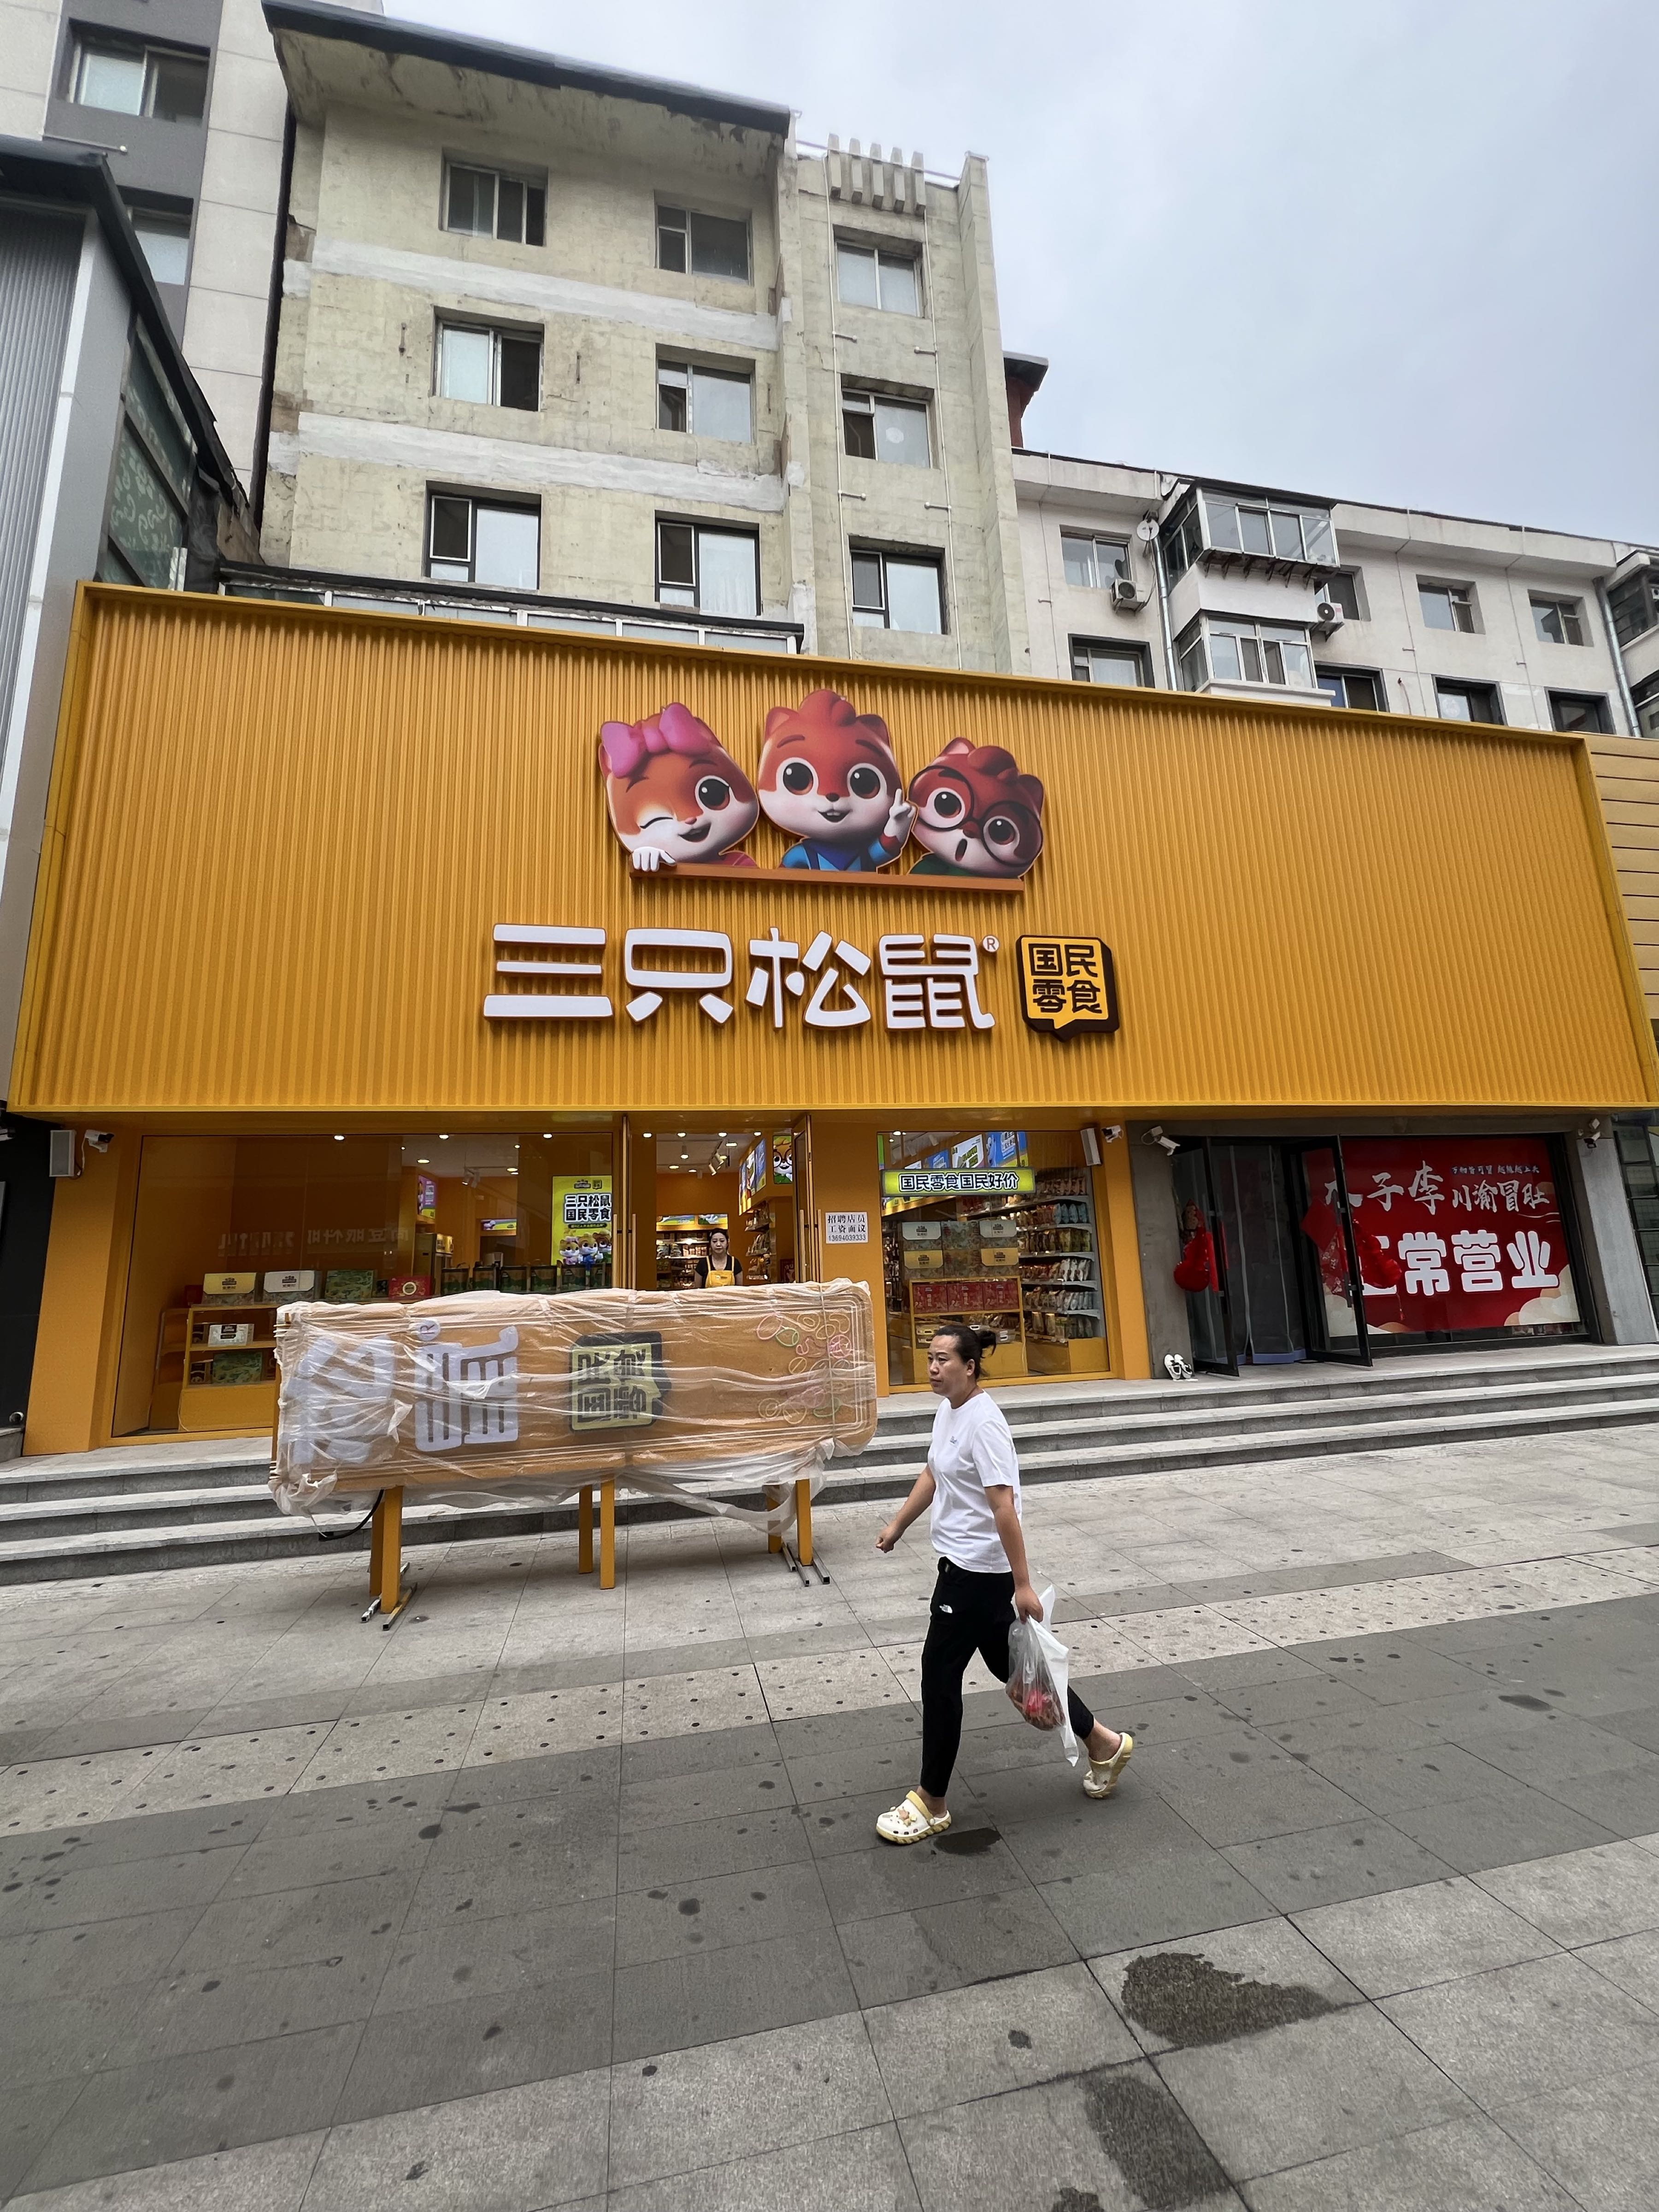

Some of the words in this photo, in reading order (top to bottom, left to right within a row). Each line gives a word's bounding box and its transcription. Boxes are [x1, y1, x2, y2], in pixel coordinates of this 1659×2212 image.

[1028, 943, 1098, 977] 国民
[483, 924, 995, 1029] 三只松鼠
[1033, 978, 1102, 1013] 零食
[901, 1172, 1018, 1189] 国民零食国民好价
[566, 1194, 611, 1207] 三只松鼠
[1452, 1180, 1549, 1212] 川渝冒肚
[566, 1208, 610, 1221] 国民零食
[828, 1214, 865, 1224] 招聘店员
[829, 1224, 865, 1233] 工资面议
